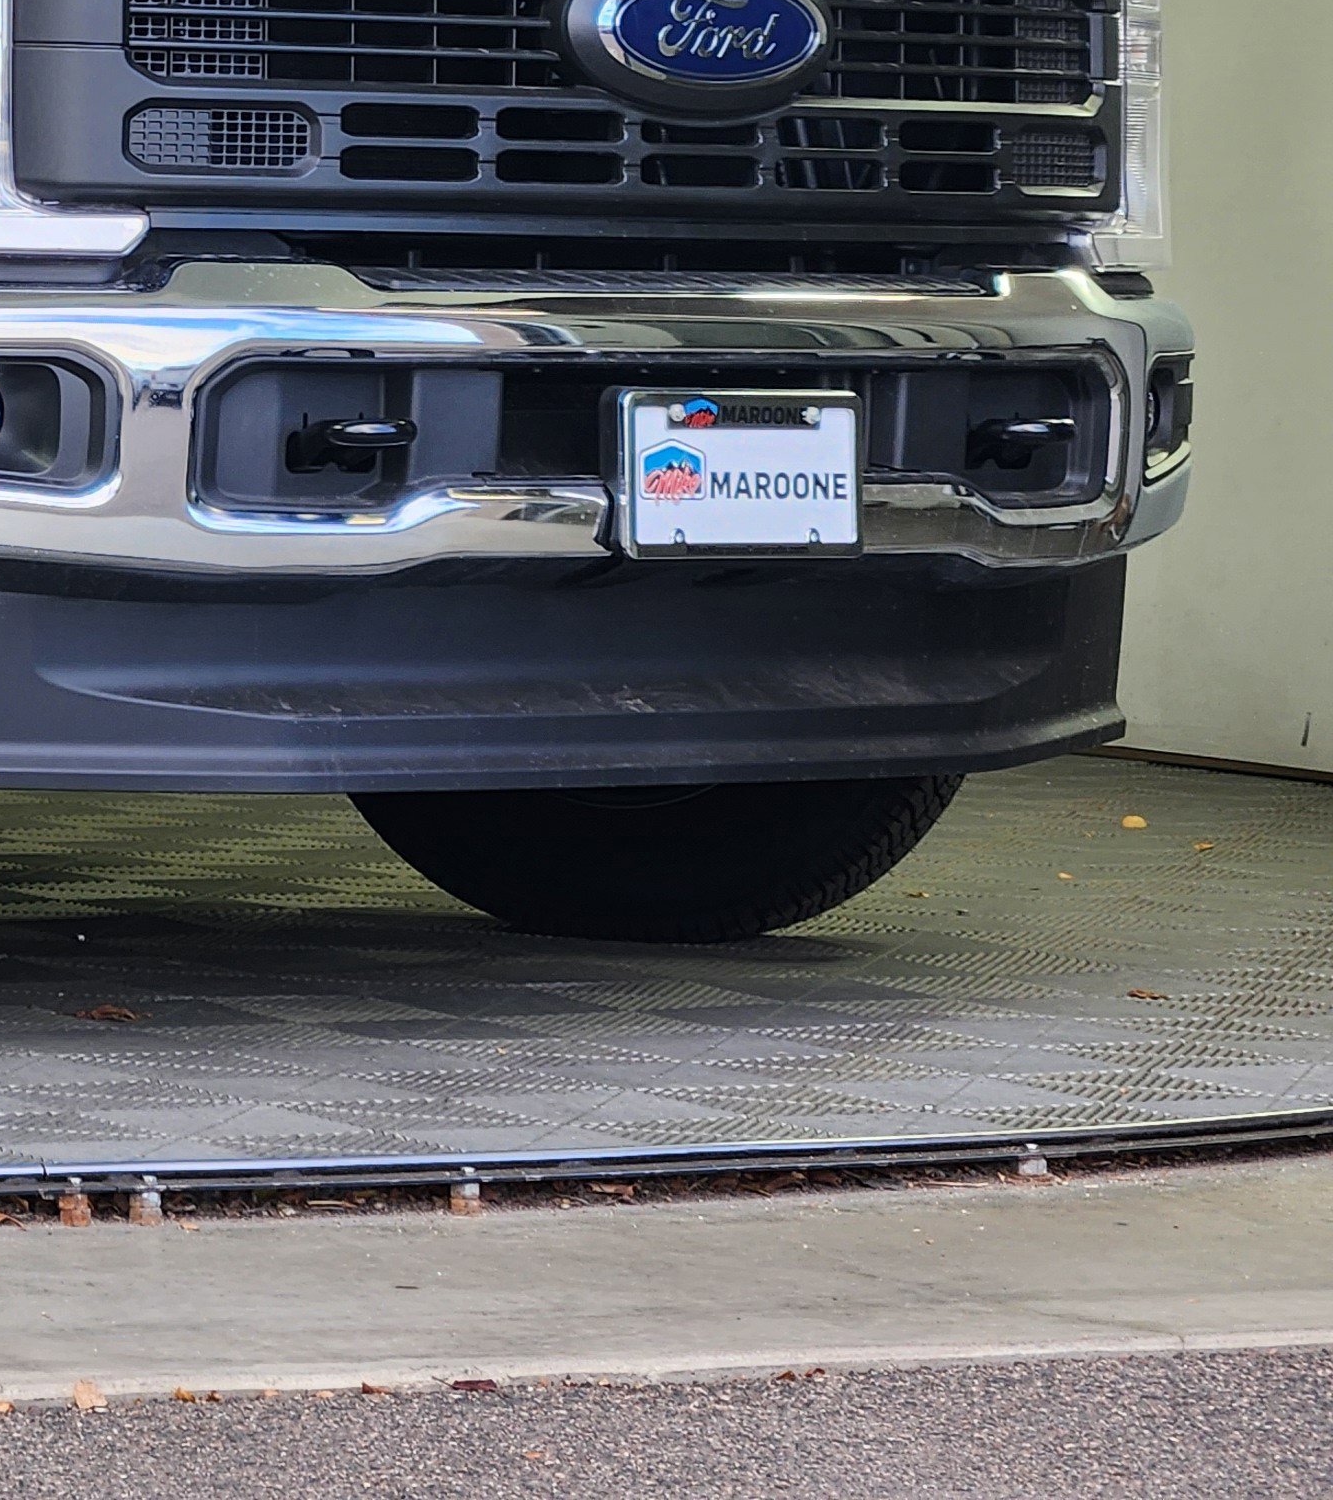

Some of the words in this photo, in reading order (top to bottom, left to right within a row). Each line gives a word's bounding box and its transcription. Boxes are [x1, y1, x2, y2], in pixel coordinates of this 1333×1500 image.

[720, 404, 808, 425] MAROONE
[644, 466, 702, 504] Mike
[710, 472, 848, 500] MAROONE
